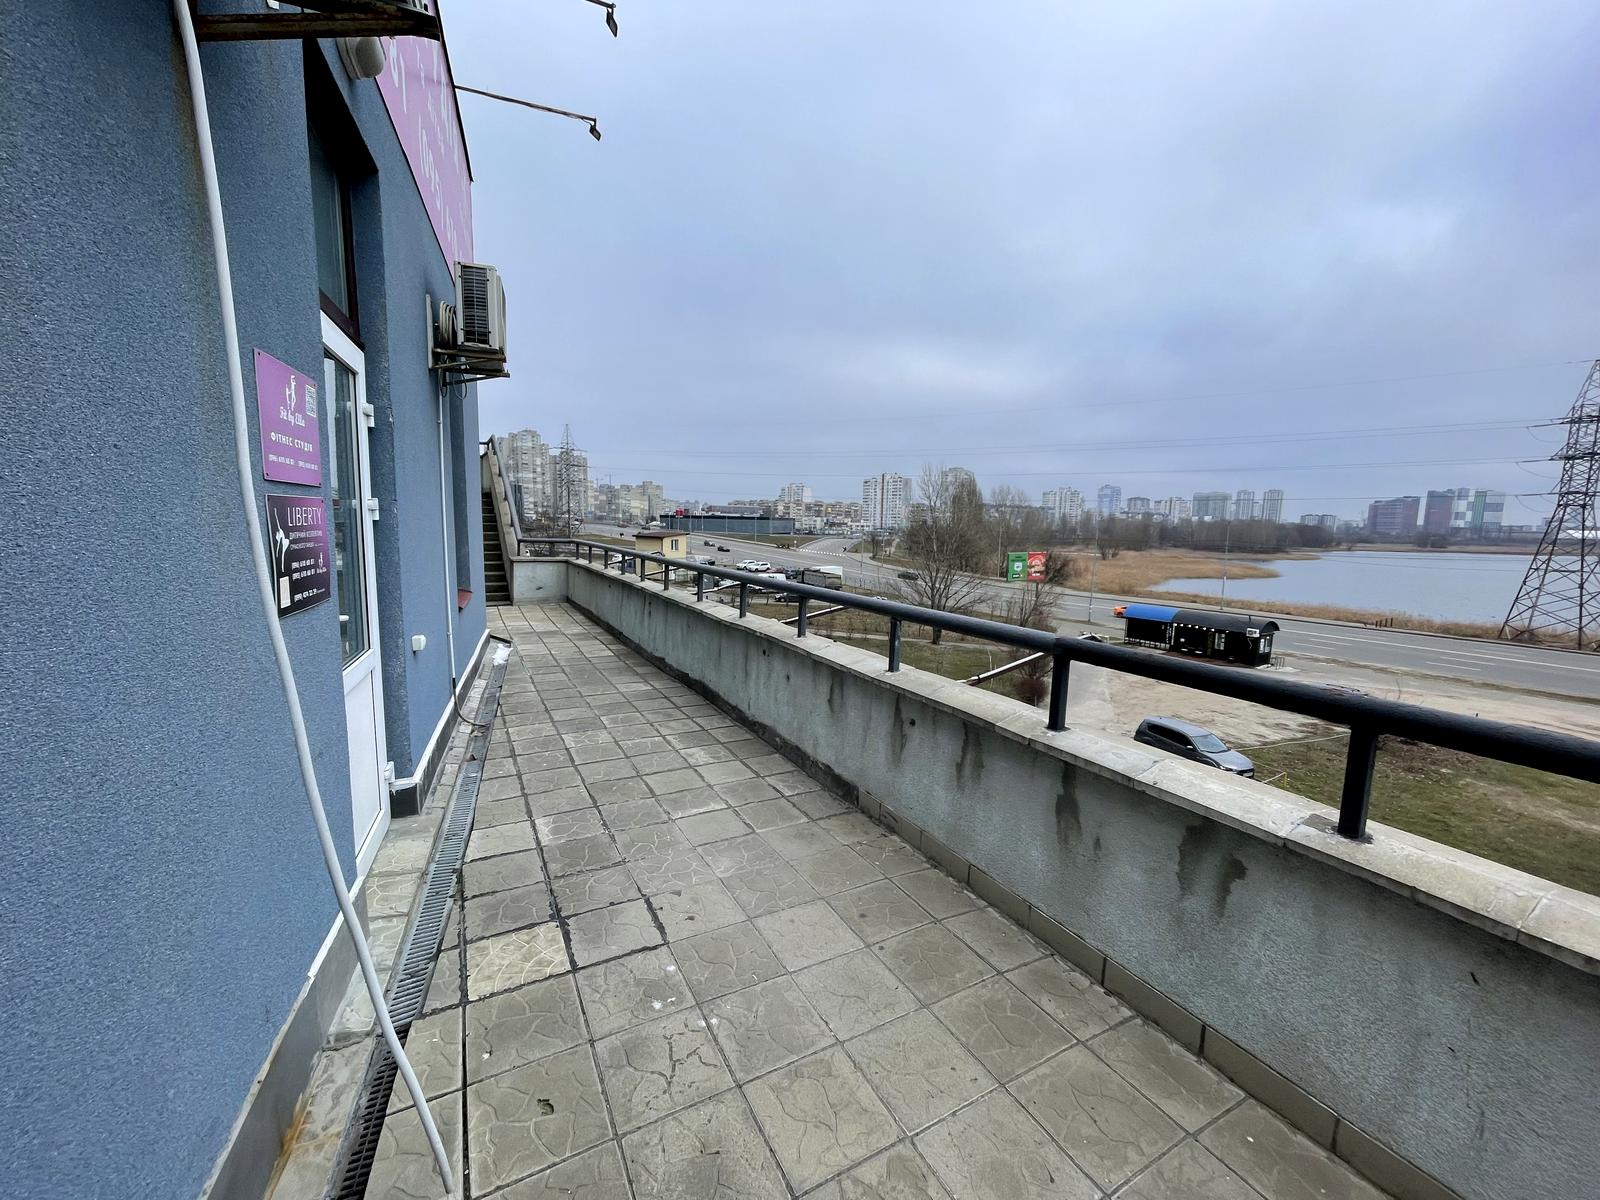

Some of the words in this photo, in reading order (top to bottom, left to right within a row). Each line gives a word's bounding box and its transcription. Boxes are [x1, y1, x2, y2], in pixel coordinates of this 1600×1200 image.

[270, 431, 293, 446] ФІТНЕС
[294, 439, 313, 452] СТУДІЯ
[287, 507, 322, 527] LIBERTY
